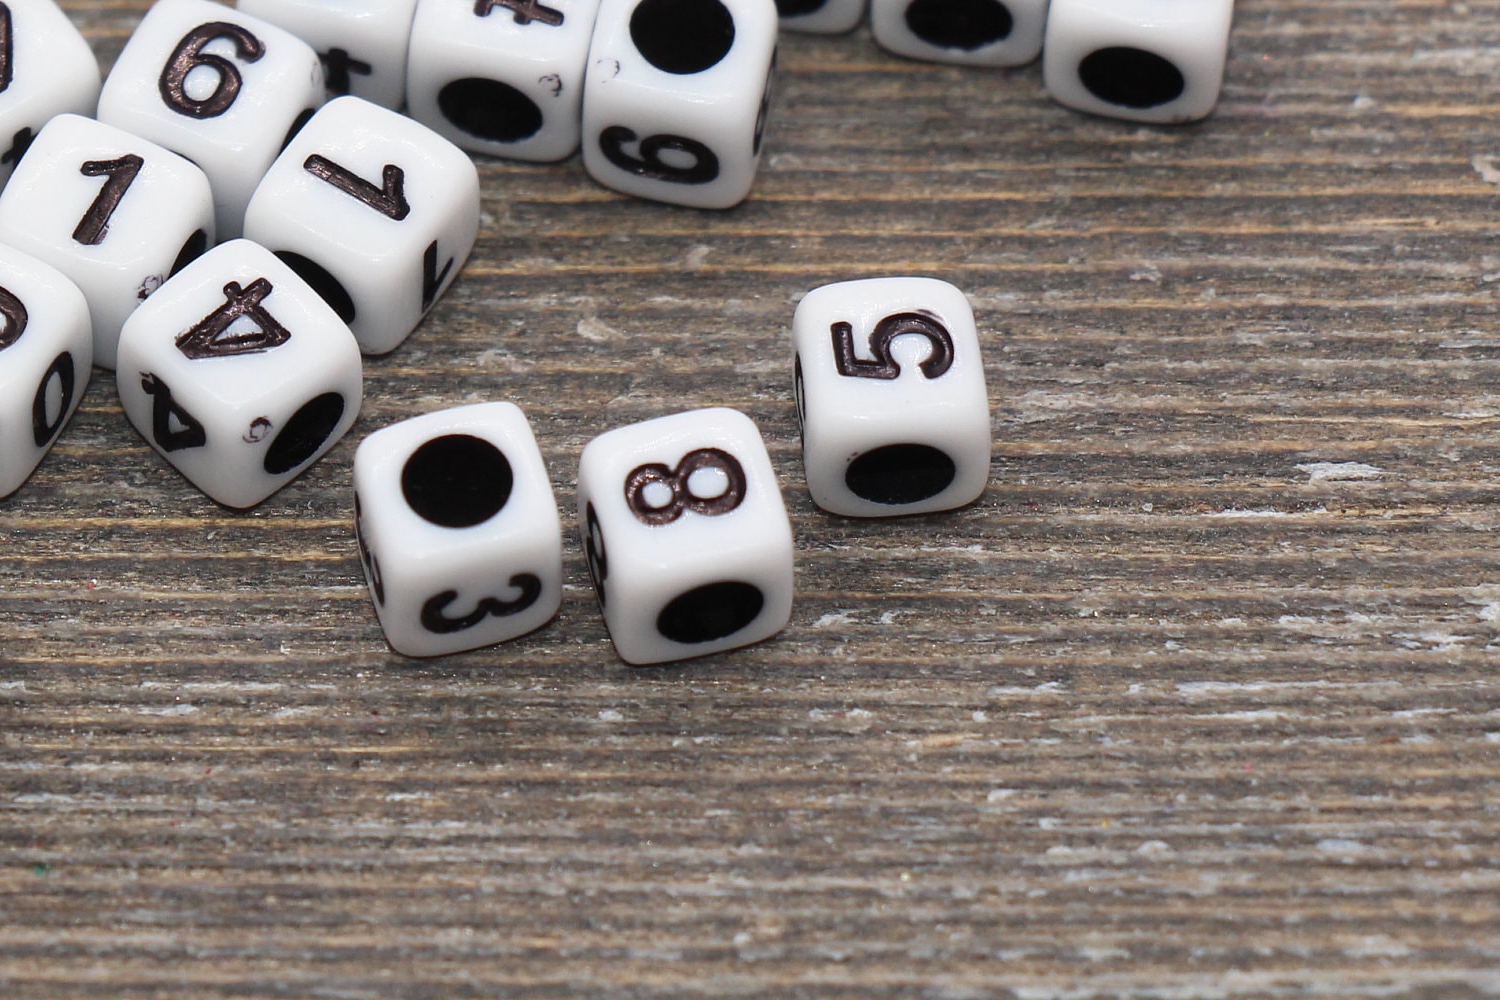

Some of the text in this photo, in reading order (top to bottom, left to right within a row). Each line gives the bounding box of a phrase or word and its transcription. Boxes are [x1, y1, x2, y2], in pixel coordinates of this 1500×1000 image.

[158, 21, 265, 119] 6
[72, 154, 144, 245] 1
[303, 154, 410, 221] 1
[175, 278, 291, 360] 4
[831, 309, 954, 380] 5
[32, 350, 75, 448] 0
[138, 370, 207, 453] 4
[624, 448, 747, 526] 8
[419, 572, 544, 635] 3
